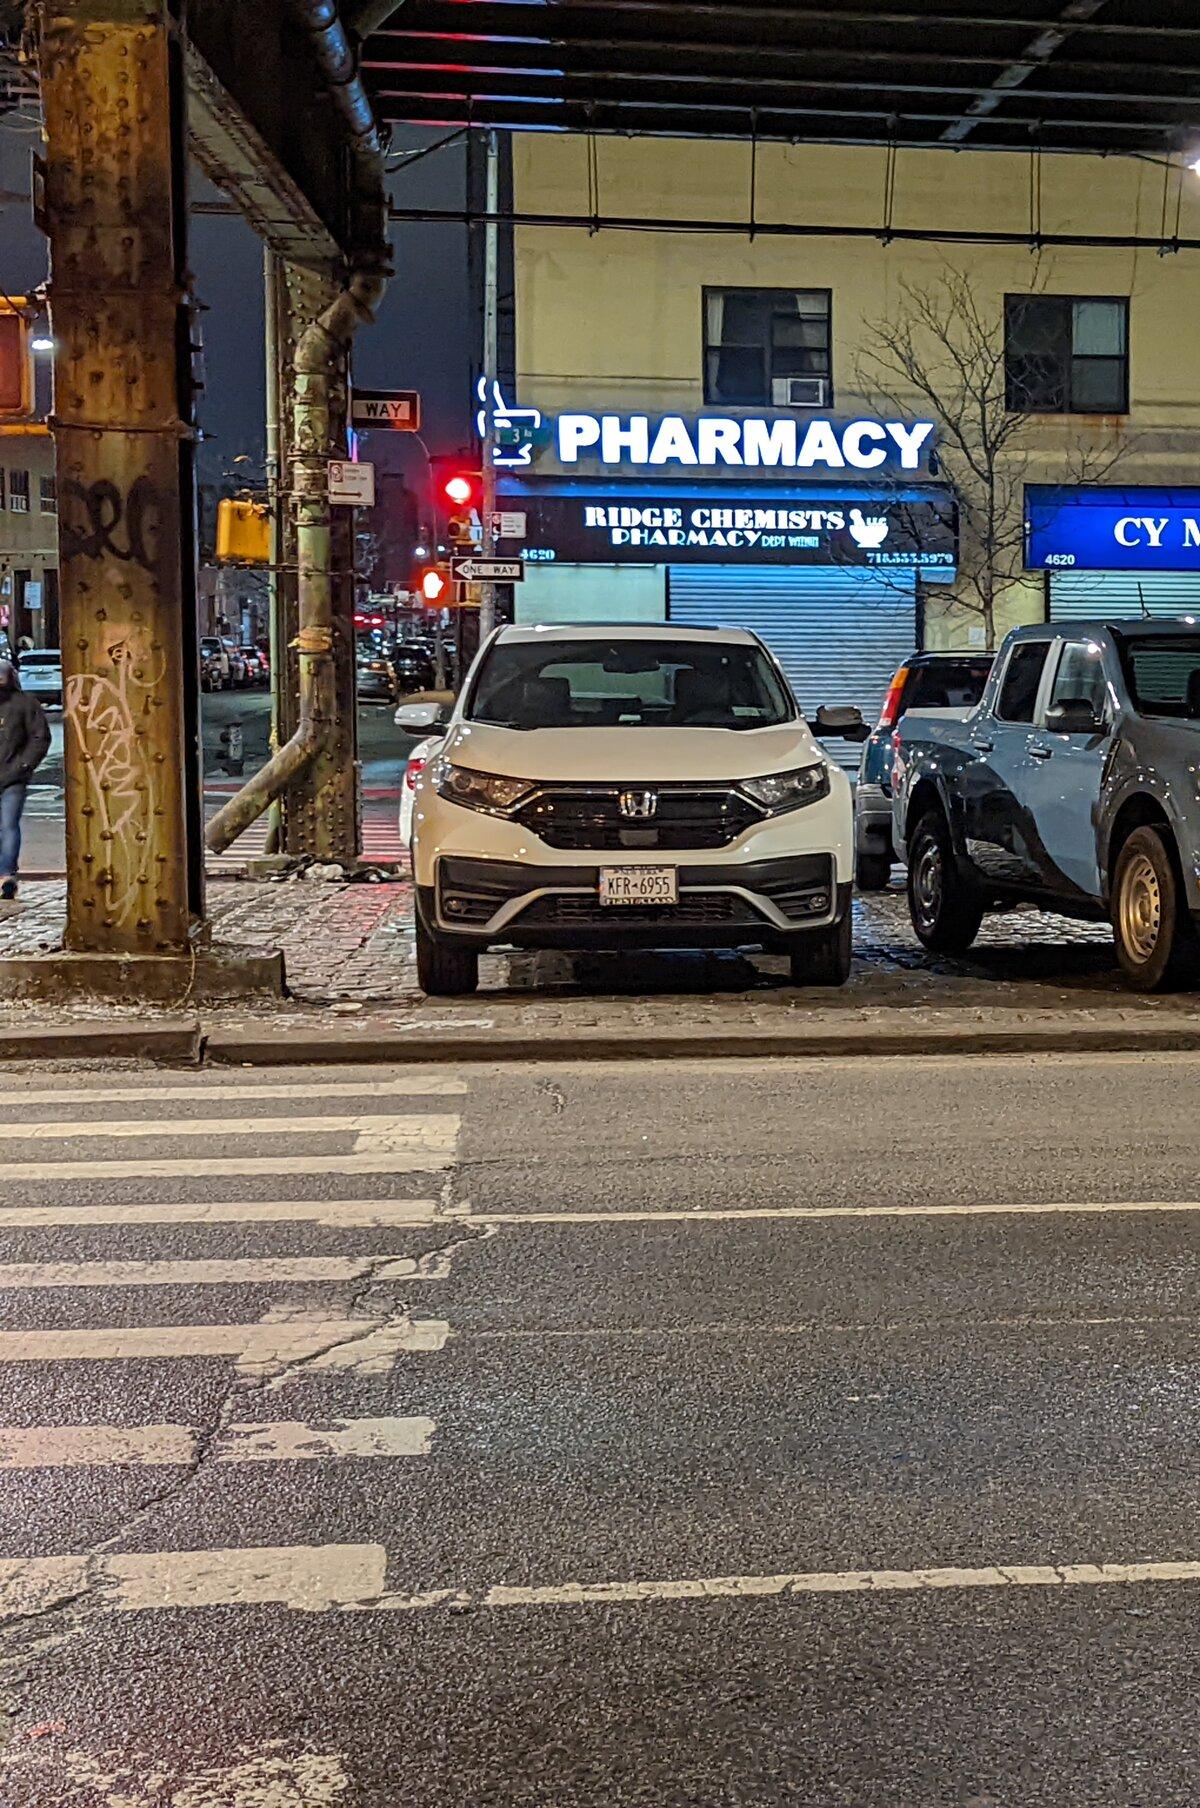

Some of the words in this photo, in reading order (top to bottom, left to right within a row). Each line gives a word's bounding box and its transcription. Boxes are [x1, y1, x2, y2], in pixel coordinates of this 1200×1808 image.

[366, 403, 402, 418] WAY
[512, 428, 520, 443] 3
[558, 415, 933, 469] PHARMACY
[585, 506, 682, 528] RIDGE
[691, 508, 846, 530] CHEMISTS
[611, 528, 761, 547] PHARMACY
[1114, 517, 1169, 546] CY
[519, 548, 556, 560] 4620
[1045, 554, 1075, 566] 4620
[462, 564, 483, 574] ONE
[493, 564, 515, 574] WAY
